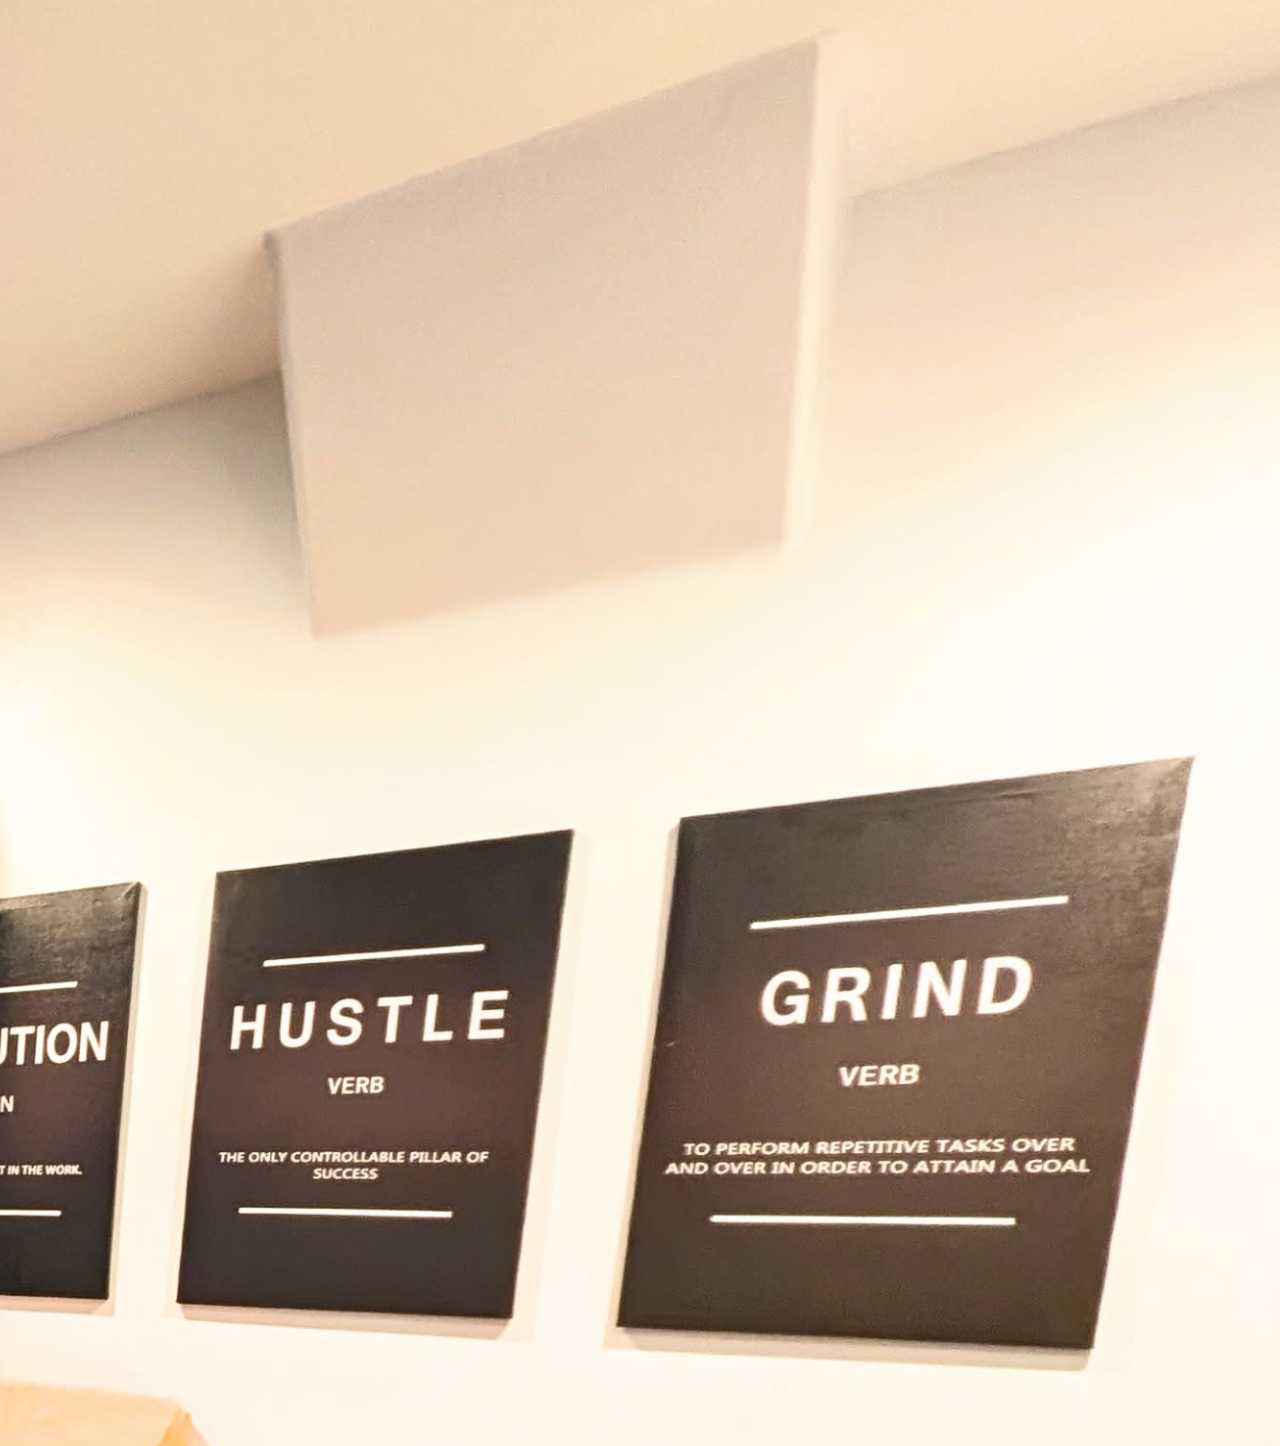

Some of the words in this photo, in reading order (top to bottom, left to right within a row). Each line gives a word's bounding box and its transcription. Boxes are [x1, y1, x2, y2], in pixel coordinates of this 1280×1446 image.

[760, 954, 1034, 1027] GRIND
[229, 989, 510, 1051] HUSTLE
[838, 1063, 921, 1087] VERB
[327, 1075, 385, 1095] VERB
[683, 1142, 711, 1156] TO
[714, 1141, 810, 1156] PERFORM
[814, 1139, 931, 1155] REPETITIVE
[935, 1137, 1006, 1154] TASKS
[1011, 1137, 1076, 1153] OVER
[218, 1151, 246, 1164] THE
[248, 1151, 288, 1164] ONLY
[290, 1151, 406, 1164] CONTROLLABLE
[408, 1150, 463, 1164] PILLAR
[465, 1150, 490, 1164] OF
[664, 1161, 709, 1175] AND
[713, 1161, 767, 1175] OVER
[770, 1161, 796, 1175] IN
[799, 1160, 872, 1175] ORDER
[877, 1159, 909, 1175] TO
[912, 1159, 996, 1174] ATTAIN
[1000, 1159, 1020, 1174] A
[1024, 1158, 1091, 1174] GOAL
[6, 1164, 20, 1176] IN
[22, 1164, 44, 1176] THE
[44, 1164, 83, 1176] WORK.
[312, 1167, 379, 1180] SUCCESS
